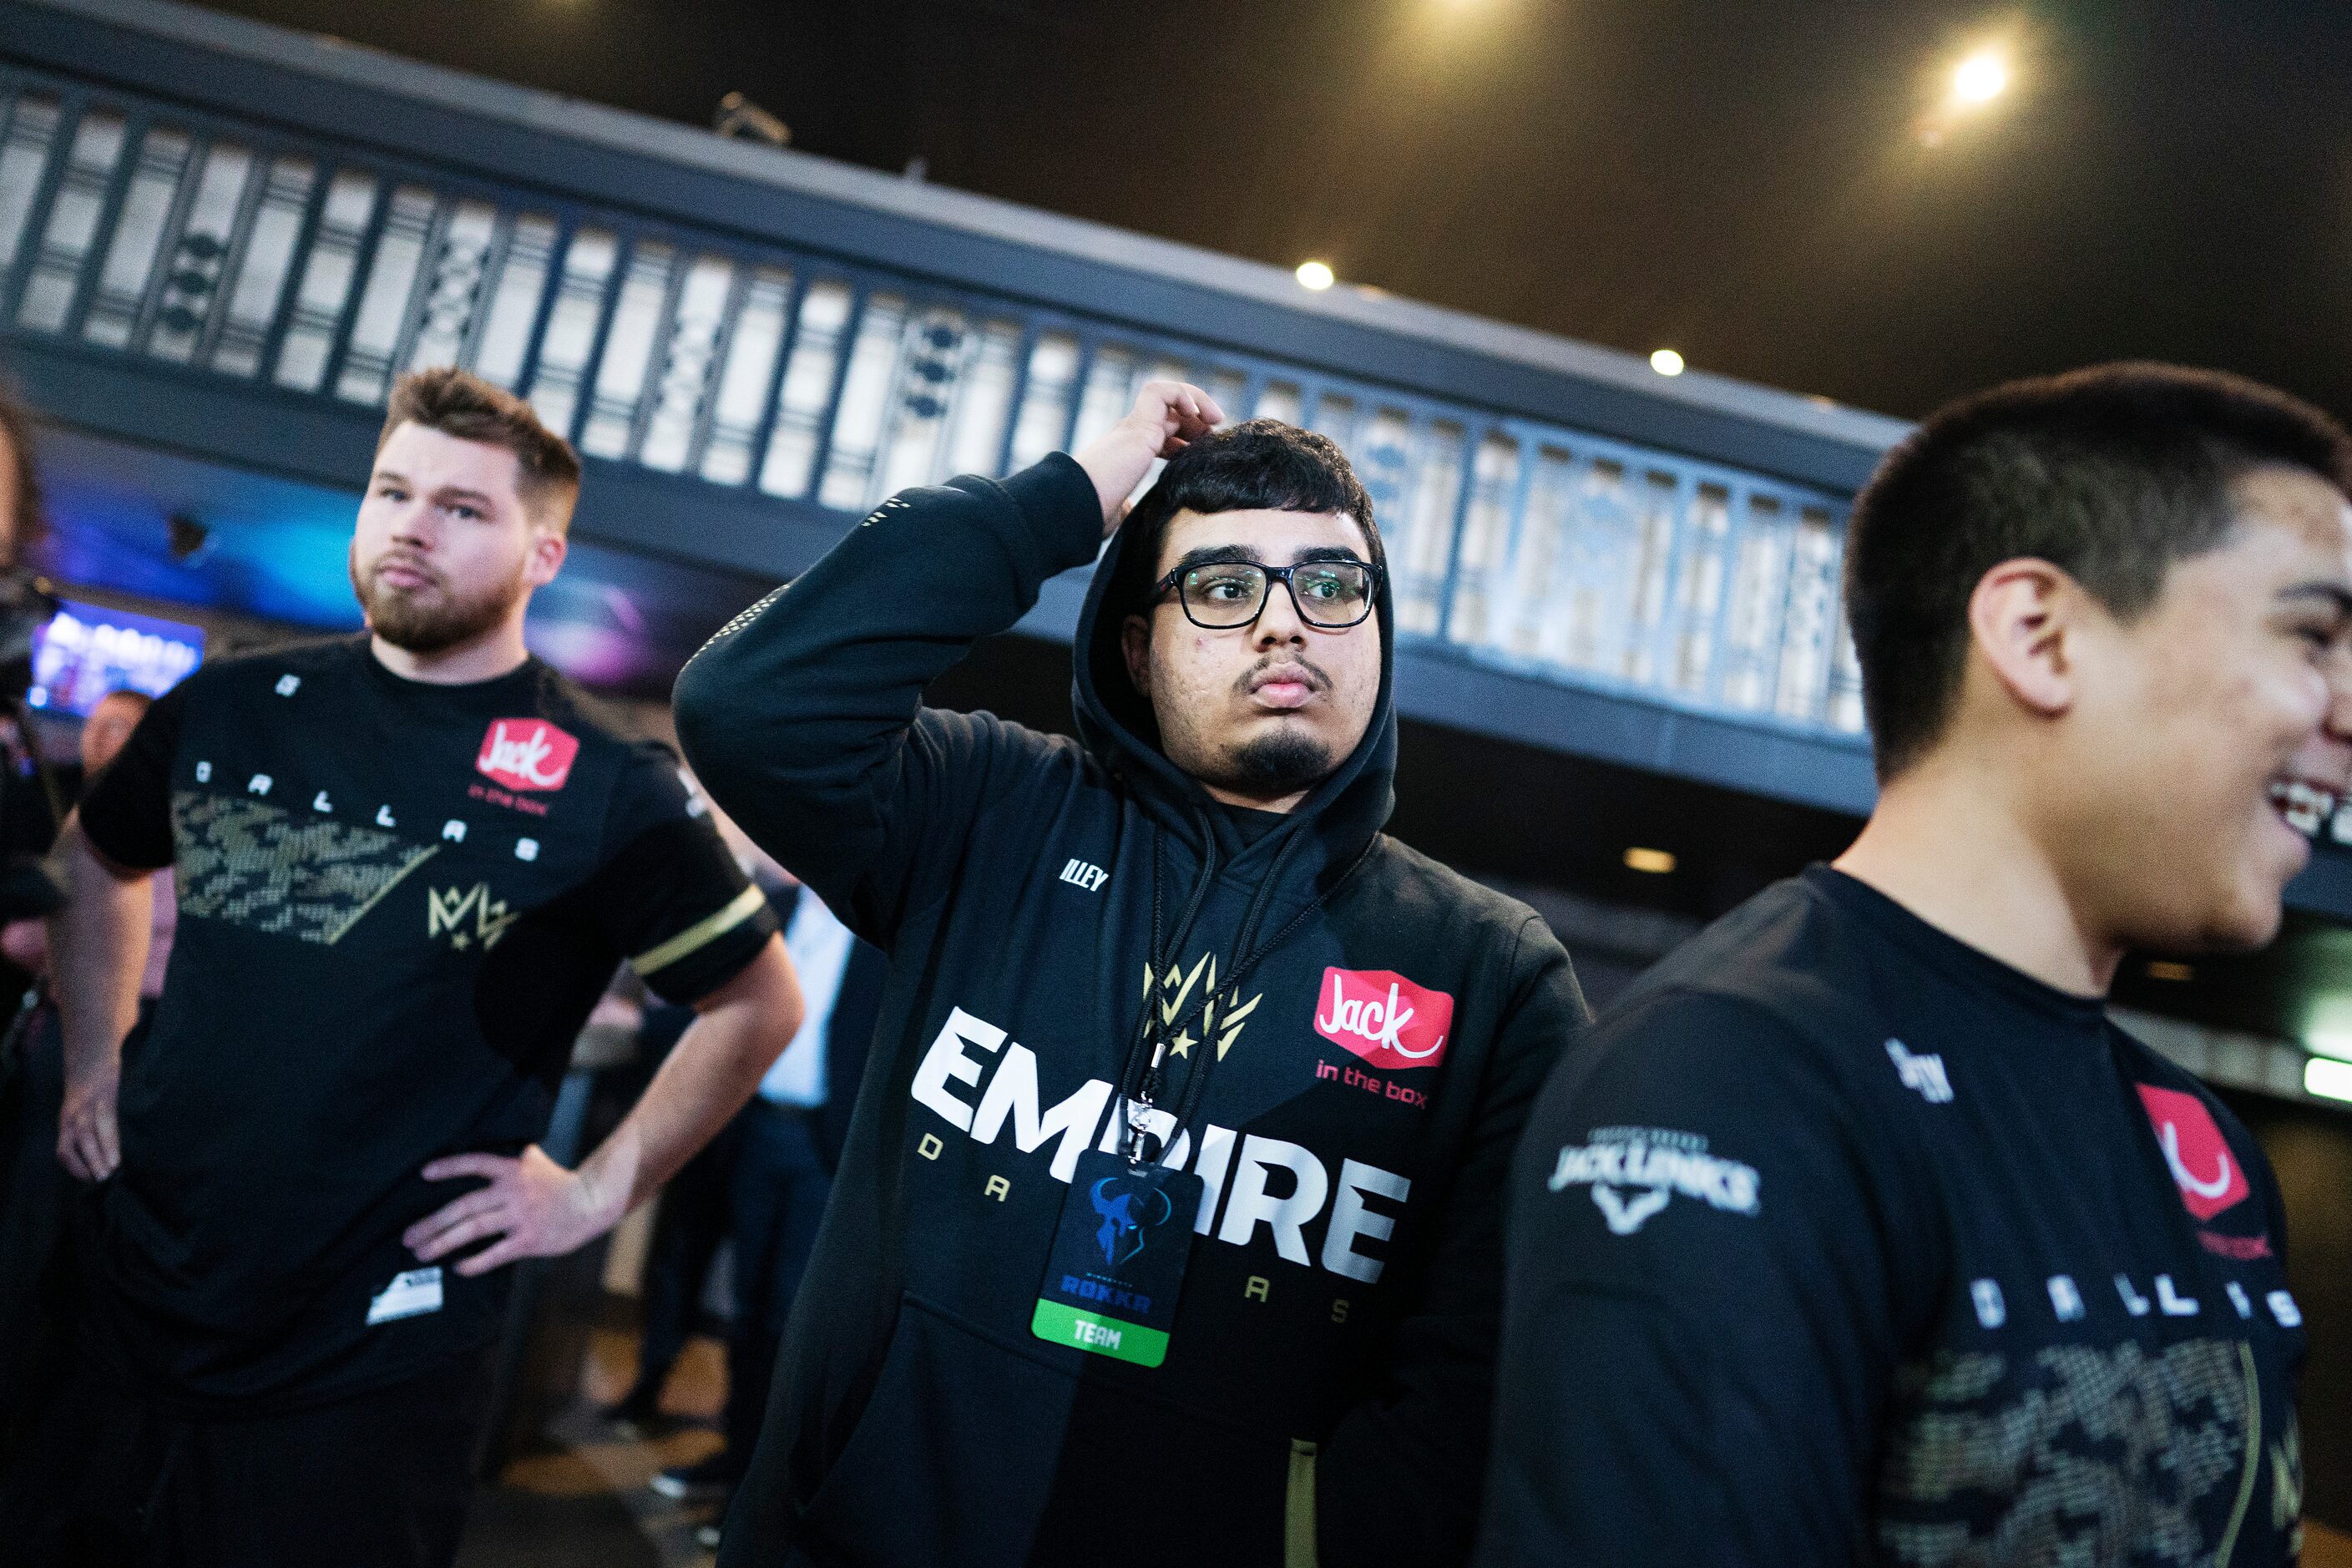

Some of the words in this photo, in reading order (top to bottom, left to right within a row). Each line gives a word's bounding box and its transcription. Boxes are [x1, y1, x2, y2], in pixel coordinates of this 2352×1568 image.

[478, 721, 567, 787] Jack
[1059, 858, 1110, 892] ILLEY
[1318, 973, 1444, 1060] Jack
[1315, 1058, 1339, 1081] in
[1343, 1065, 1382, 1095] the
[1384, 1080, 1429, 1110] box
[911, 1005, 1412, 1285] EMPIRE
[1074, 1318, 1122, 1351] TEAM
